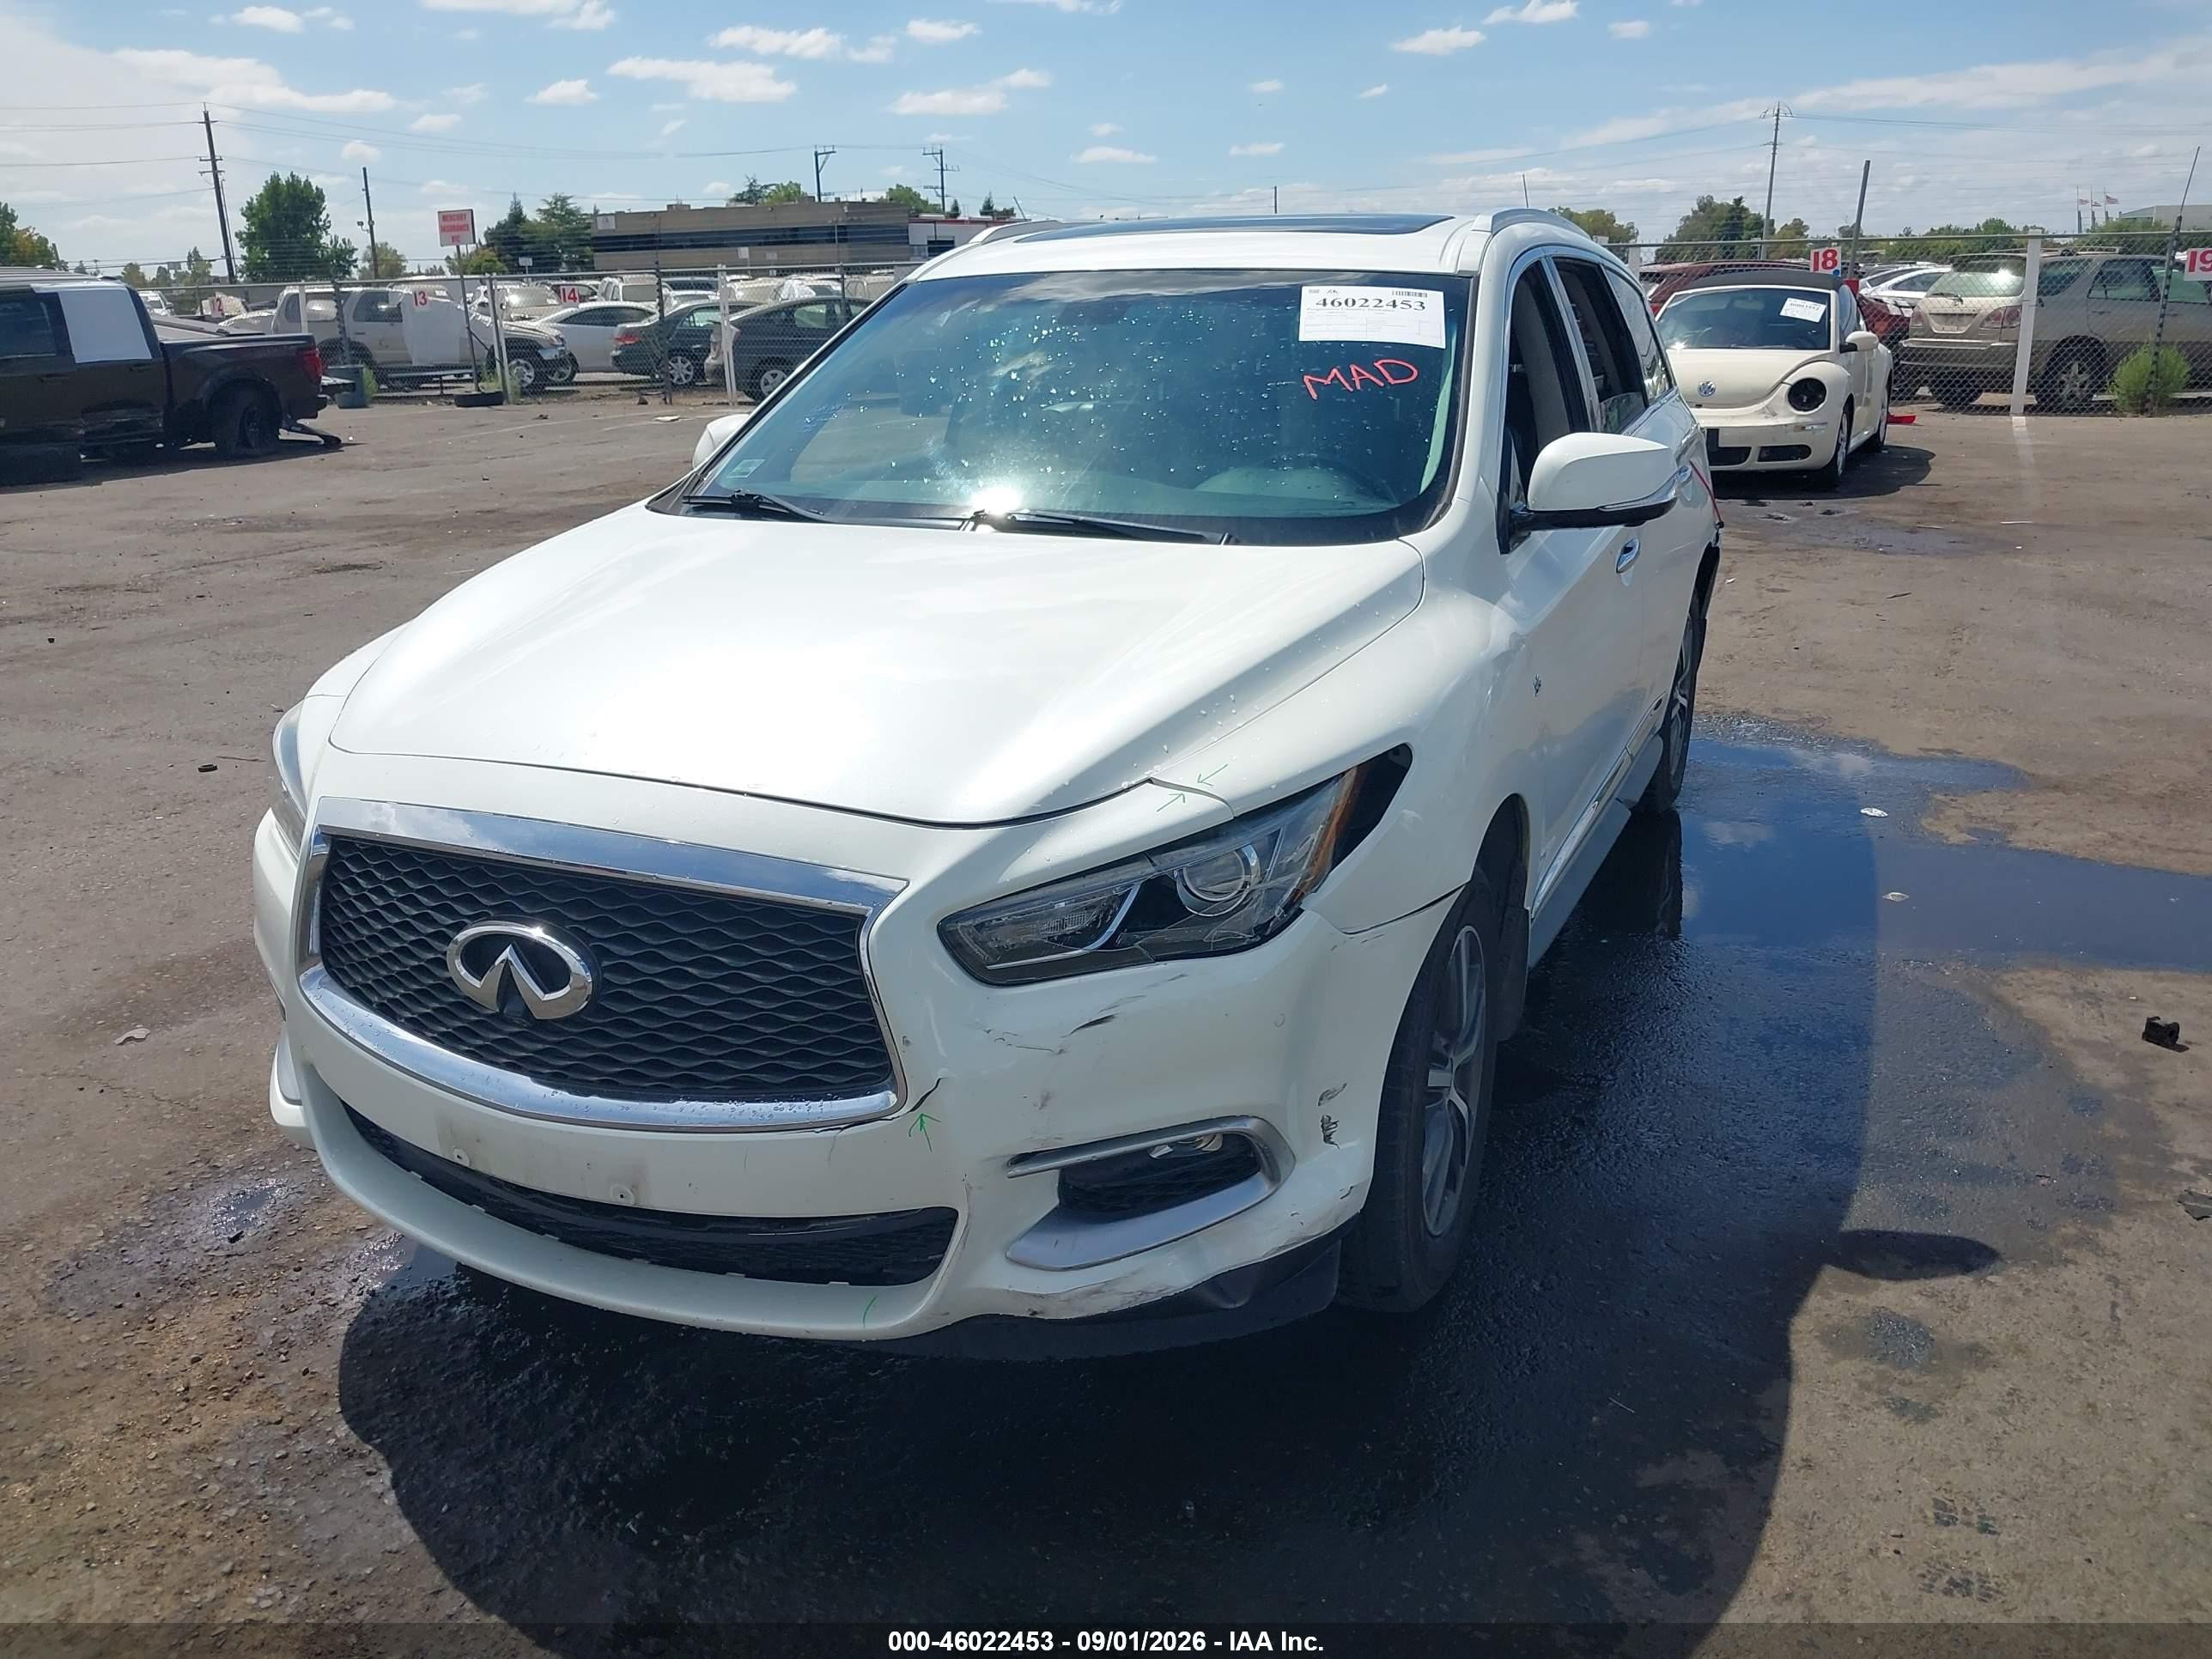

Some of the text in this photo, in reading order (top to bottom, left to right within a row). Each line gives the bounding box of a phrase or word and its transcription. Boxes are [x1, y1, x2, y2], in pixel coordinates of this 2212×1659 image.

[1813, 249, 1838, 271] 18
[2188, 249, 2212, 273] 19
[413, 290, 428, 307] 13
[562, 288, 578, 303] 14
[1316, 296, 1426, 312] 46022453
[1303, 359, 1419, 401] MAD
